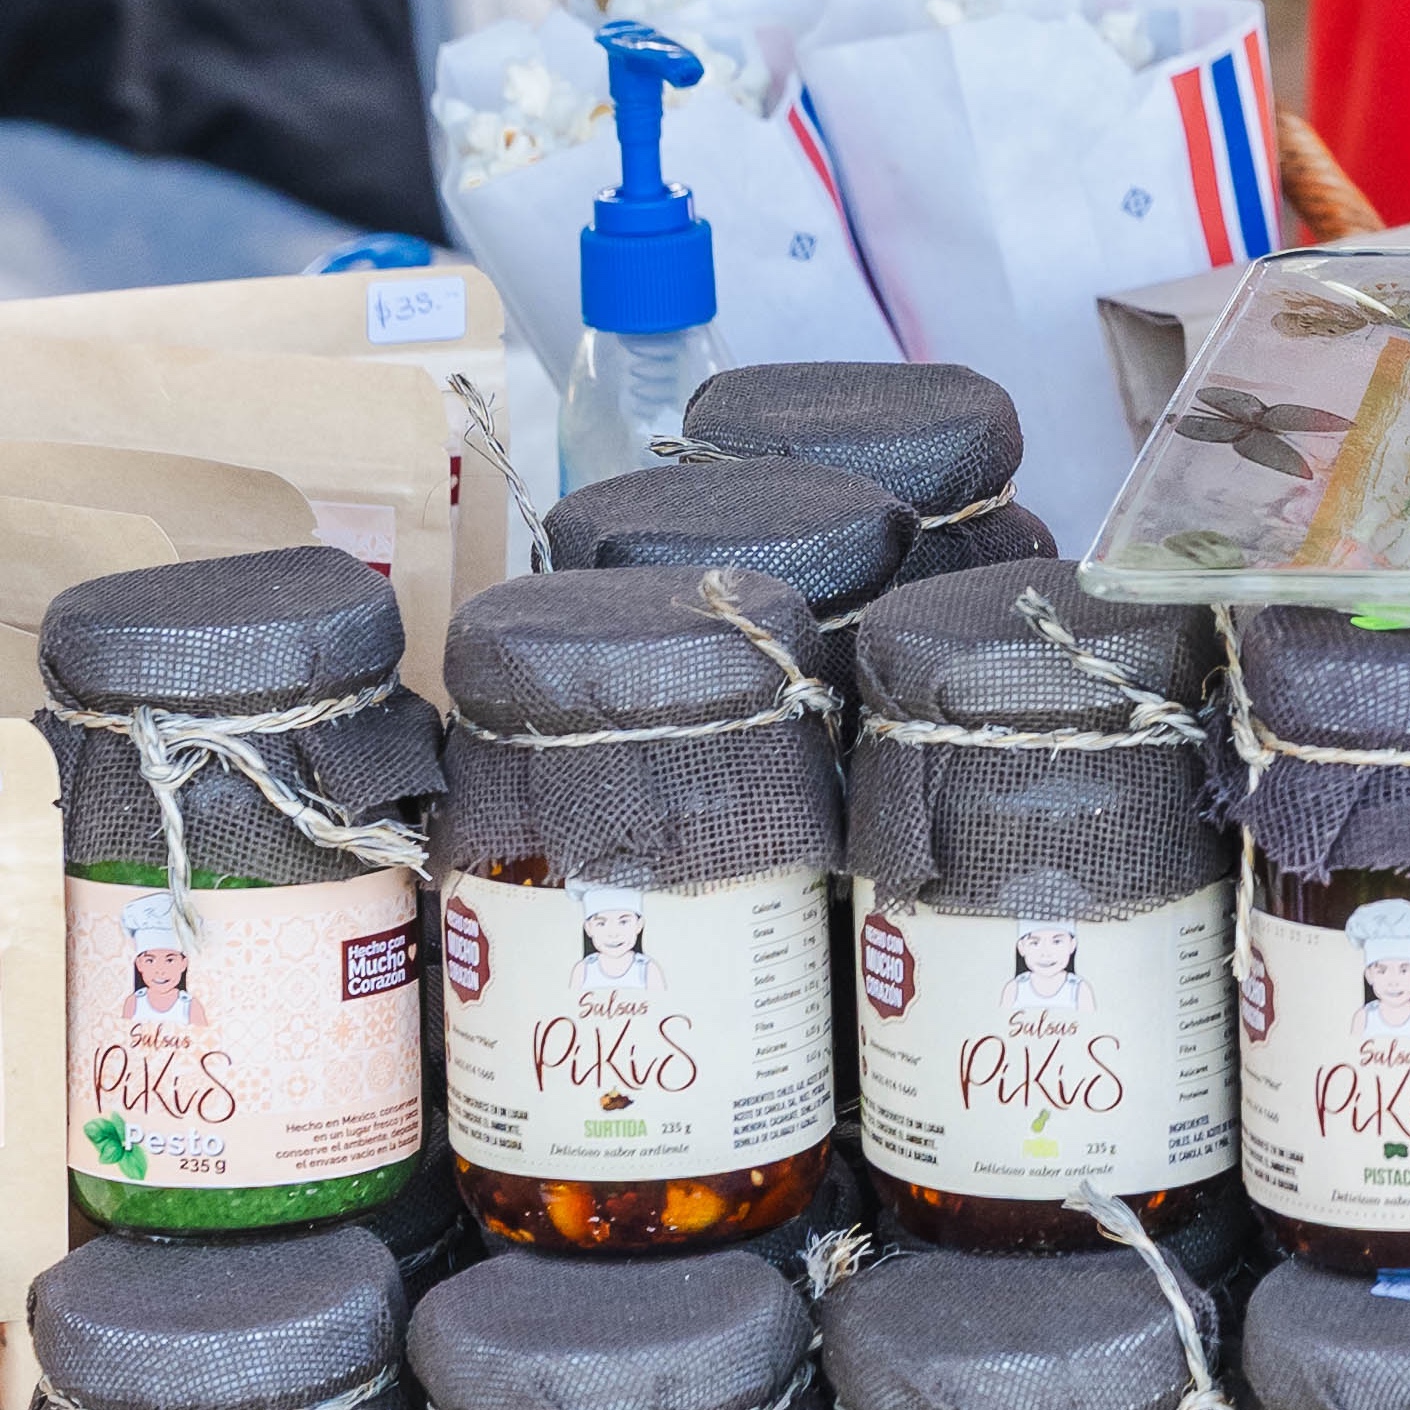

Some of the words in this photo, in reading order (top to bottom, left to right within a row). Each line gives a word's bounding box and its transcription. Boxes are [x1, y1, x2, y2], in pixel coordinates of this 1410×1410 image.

[348, 941, 386, 959] Hecho
[387, 935, 405, 950] con
[348, 950, 405, 980] Mucho
[865, 944, 904, 983] MUCHO
[578, 990, 649, 1019] Salsas
[129, 1023, 190, 1050] Salsas
[1008, 1010, 1079, 1039] Salsas
[286, 1122, 323, 1133] Hecho
[326, 1119, 339, 1129] en
[313, 1133, 327, 1142] en
[330, 1131, 343, 1140] un
[346, 1125, 371, 1138] lugar
[374, 1117, 399, 1131] fresco
[583, 1119, 648, 1138] SURTIDA
[662, 1122, 681, 1135] 235
[123, 1122, 225, 1157] Pesto
[275, 1146, 327, 1159] conserve
[331, 1141, 341, 1152] el
[550, 1143, 600, 1158] Delicioso
[604, 1144, 636, 1158] sabor
[1087, 1142, 1106, 1155] 235
[180, 1158, 209, 1173] 235
[215, 1159, 226, 1174] g
[296, 1159, 306, 1169] el
[309, 1155, 348, 1167] envase
[377, 1145, 388, 1154] en
[389, 1141, 396, 1150] la
[973, 1161, 1025, 1177] Delicioso
[1029, 1164, 1061, 1177] sabor
